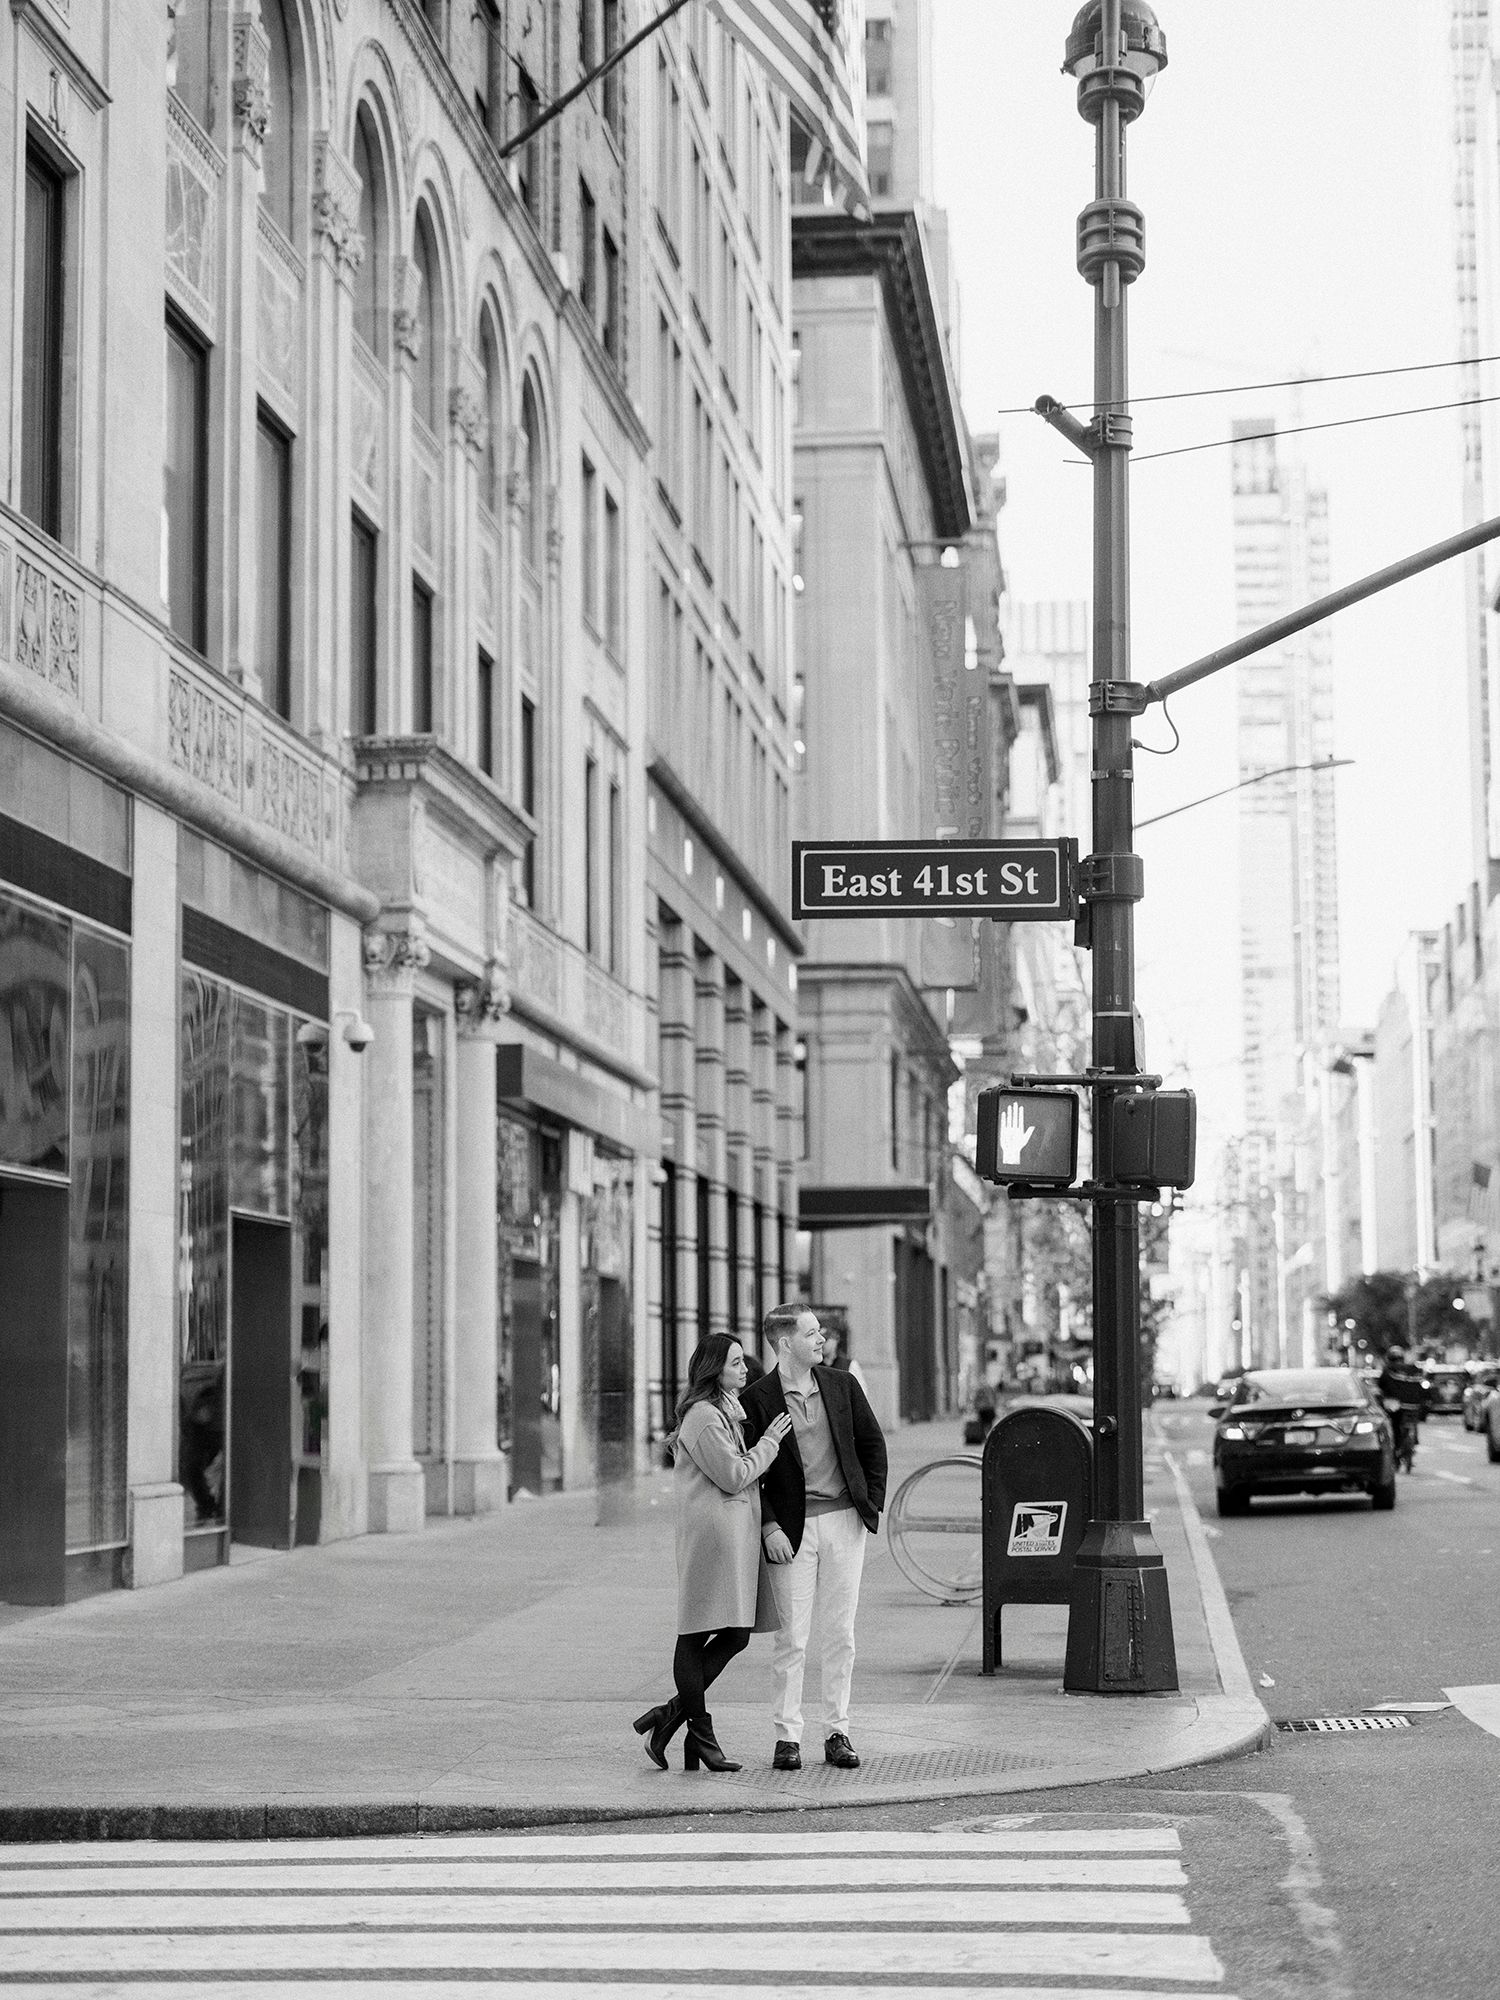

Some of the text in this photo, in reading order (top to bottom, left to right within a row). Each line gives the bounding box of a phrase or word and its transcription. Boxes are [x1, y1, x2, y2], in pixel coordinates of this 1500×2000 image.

[820, 862, 1039, 897] East 41st St
